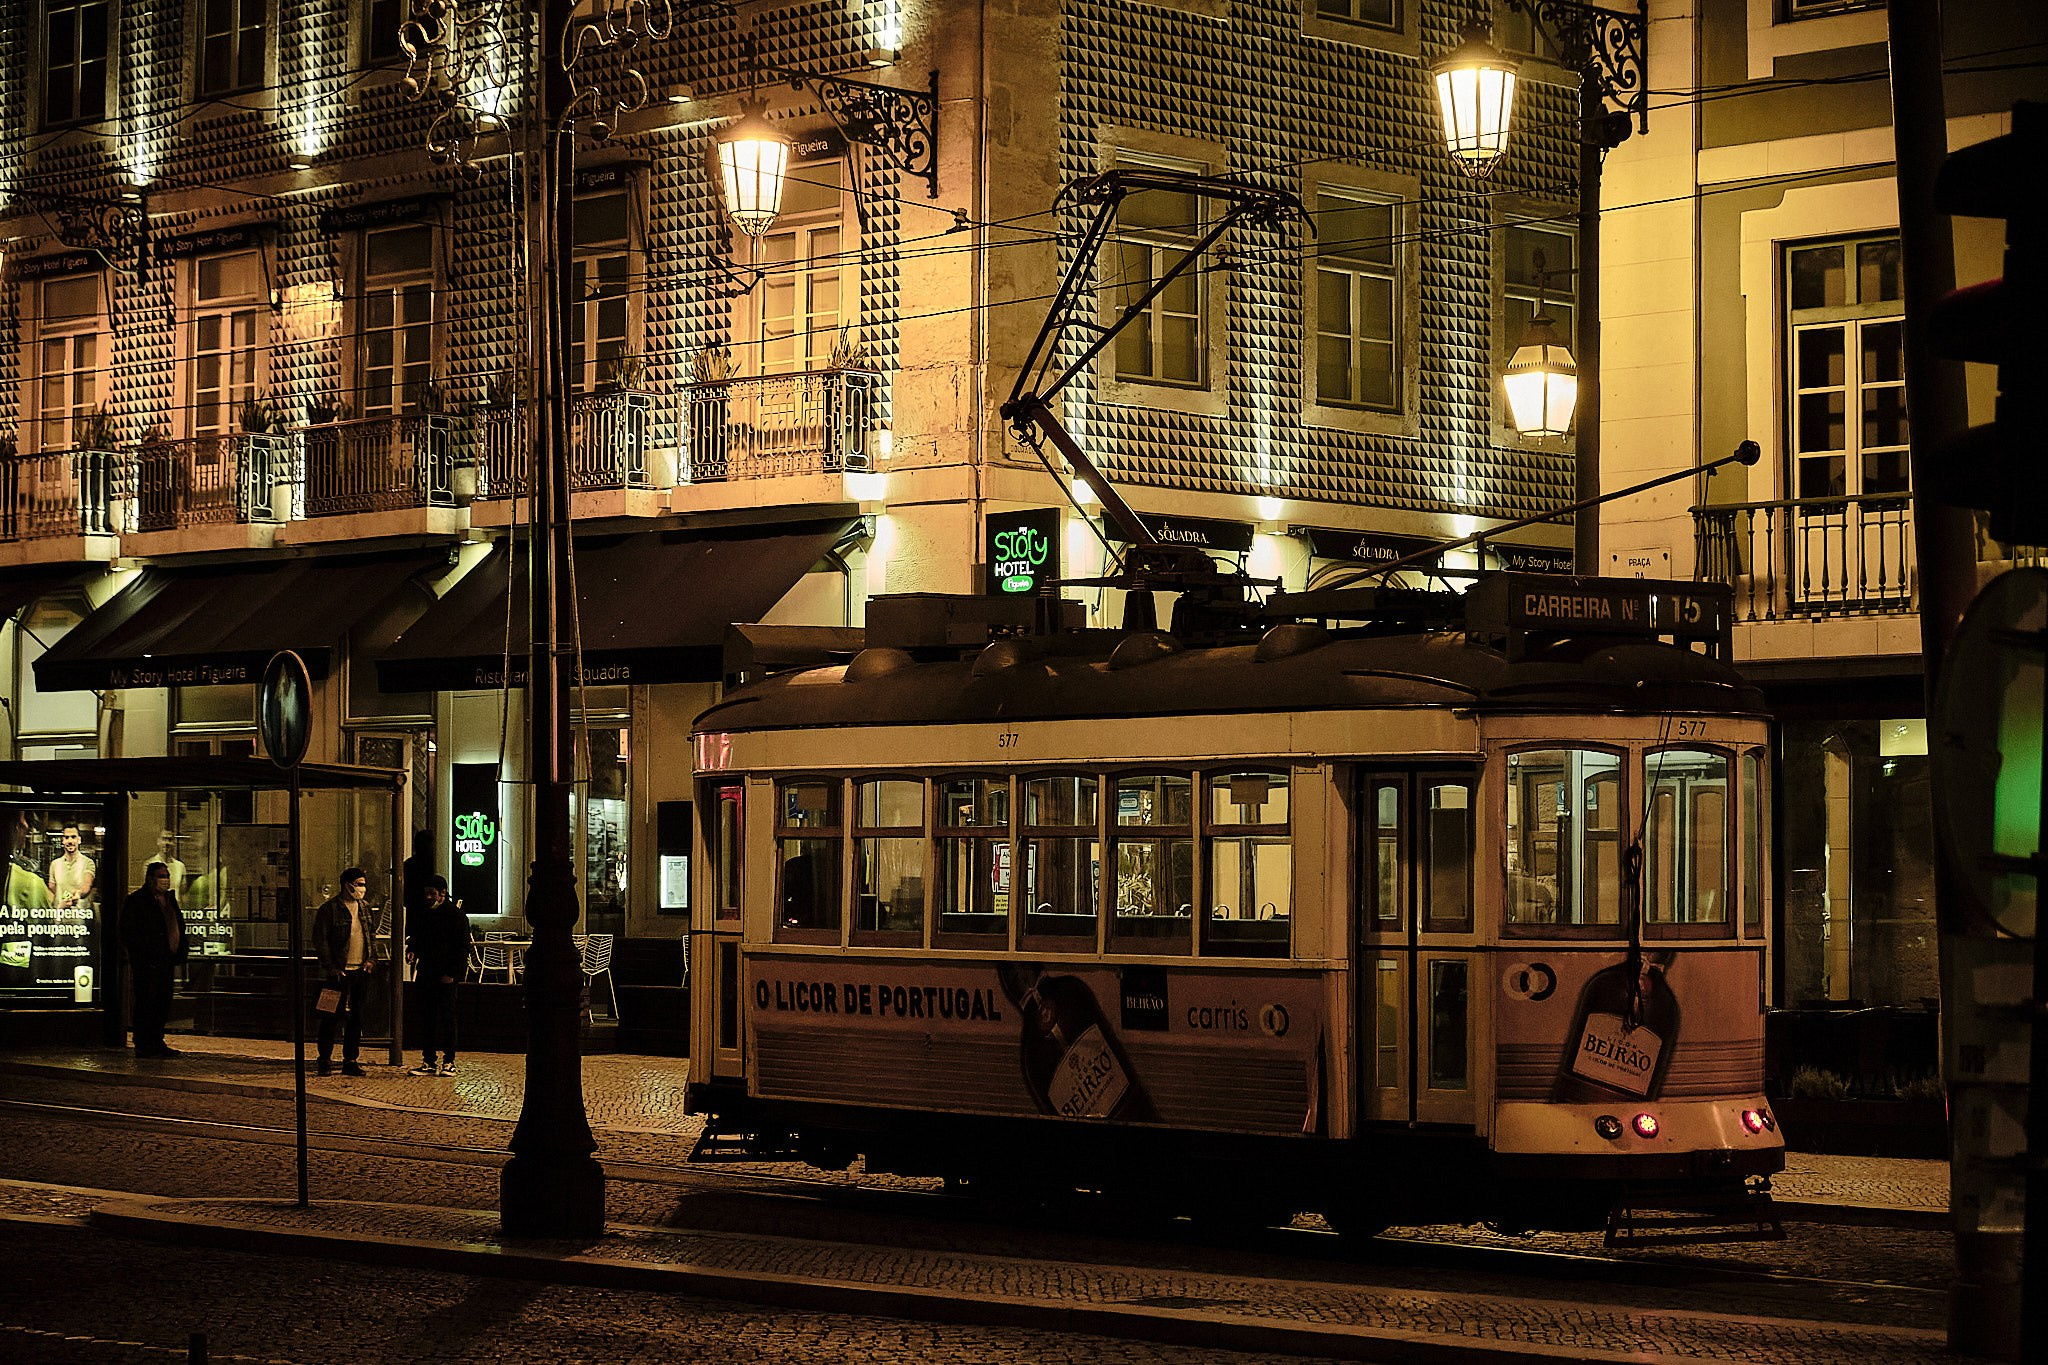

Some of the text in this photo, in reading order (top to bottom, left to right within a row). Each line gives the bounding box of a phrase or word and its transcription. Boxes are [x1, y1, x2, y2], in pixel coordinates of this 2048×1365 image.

[792, 139, 829, 156] Figueira
[583, 170, 616, 187] Figueira
[1352, 545, 1399, 561] SQUADRA
[994, 561, 1035, 577] HOTEL
[1512, 554, 1573, 571] My Story Hotel
[1628, 558, 1651, 568] PRAÇA
[1525, 594, 1612, 620] CARREIRA
[1672, 595, 1702, 624] 15
[110, 664, 246, 688] My Story Hotel Figueira
[573, 664, 631, 685] Squadra
[1678, 720, 1707, 736] 577
[998, 733, 1019, 748] 577
[455, 839, 486, 853] HOTEL
[0, 904, 94, 921] A bp compensa
[0, 920, 91, 938] pela poupança.
[756, 979, 1002, 1021] O LICOR DE PORTUGAL
[1187, 1000, 1249, 1031] carris
[1583, 1034, 1651, 1072] BEIRÃO
[1061, 1050, 1112, 1117] BEIRÃO
